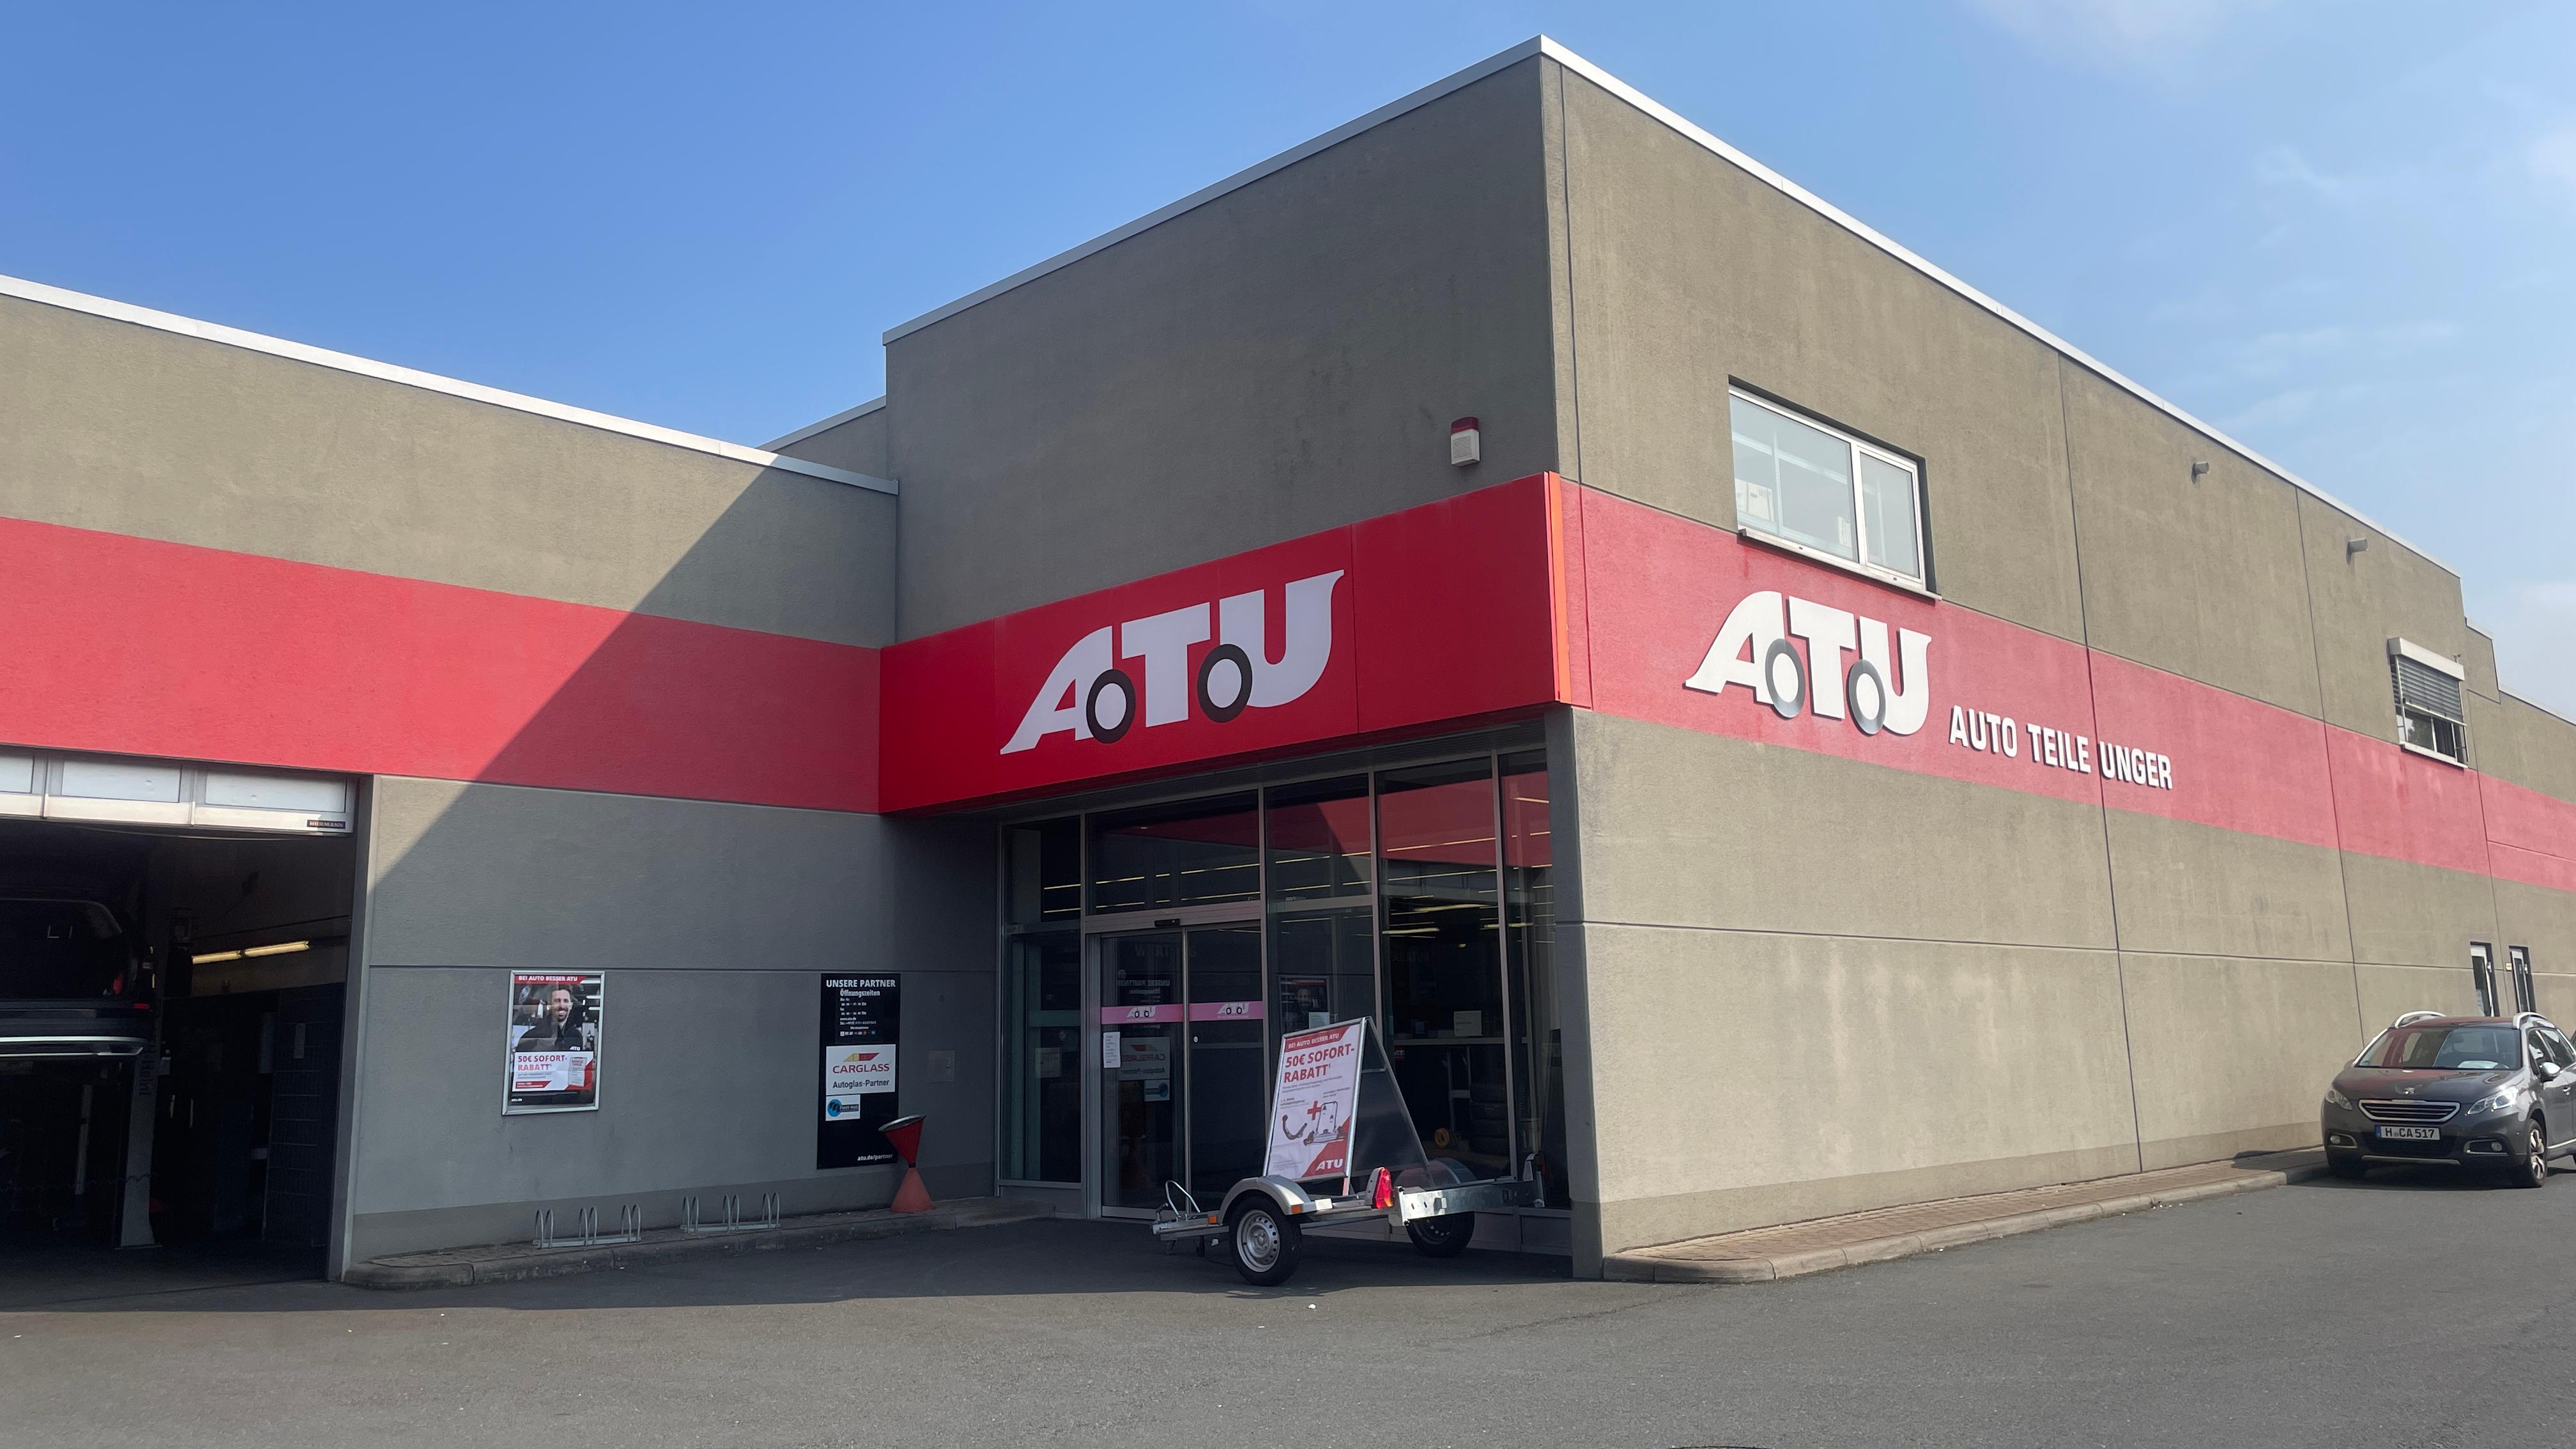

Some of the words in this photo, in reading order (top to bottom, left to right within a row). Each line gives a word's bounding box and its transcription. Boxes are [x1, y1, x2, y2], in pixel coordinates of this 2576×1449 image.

[1949, 705, 2018, 758] AUTO
[2027, 723, 2092, 774] TEILE
[2097, 740, 2172, 790] UNGER
[826, 979, 858, 988] UNSERE
[859, 979, 896, 988] PARTNER
[839, 988, 880, 998] Öffnungszeiten
[1311, 1035, 1328, 1044] BESSER
[1285, 1054, 1306, 1068] 50€
[1307, 1043, 1355, 1064] SOFORT-
[832, 1063, 890, 1074] CARGLASS
[832, 1079, 890, 1089] Autoglas-Partner
[2385, 1128, 2393, 1137] H
[2399, 1128, 2413, 1137] CA
[2415, 1129, 2435, 1138] 517
[1315, 1158, 1344, 1171] ATU
